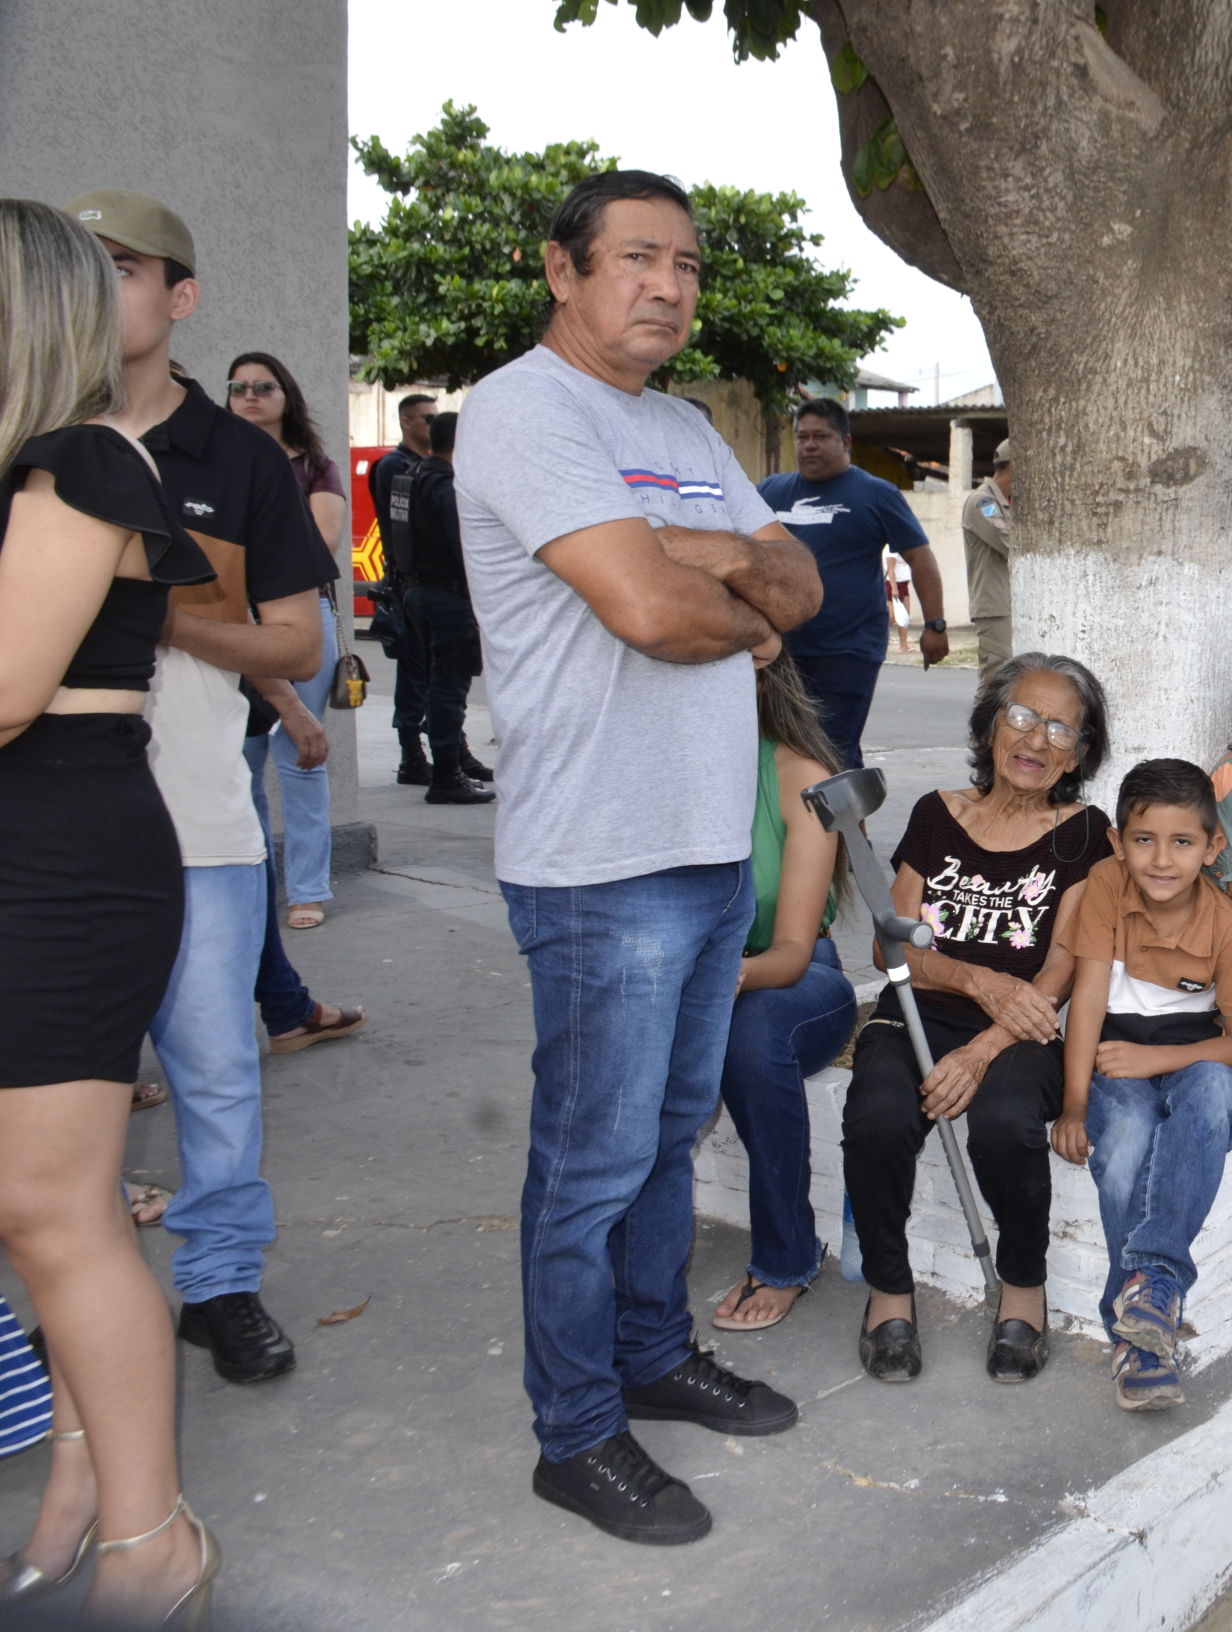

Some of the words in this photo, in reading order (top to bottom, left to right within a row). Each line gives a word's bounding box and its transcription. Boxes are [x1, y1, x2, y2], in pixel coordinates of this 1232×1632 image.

[926, 855, 1057, 906] Beauty
[952, 889, 987, 907] TAKES
[989, 896, 1014, 908] THE
